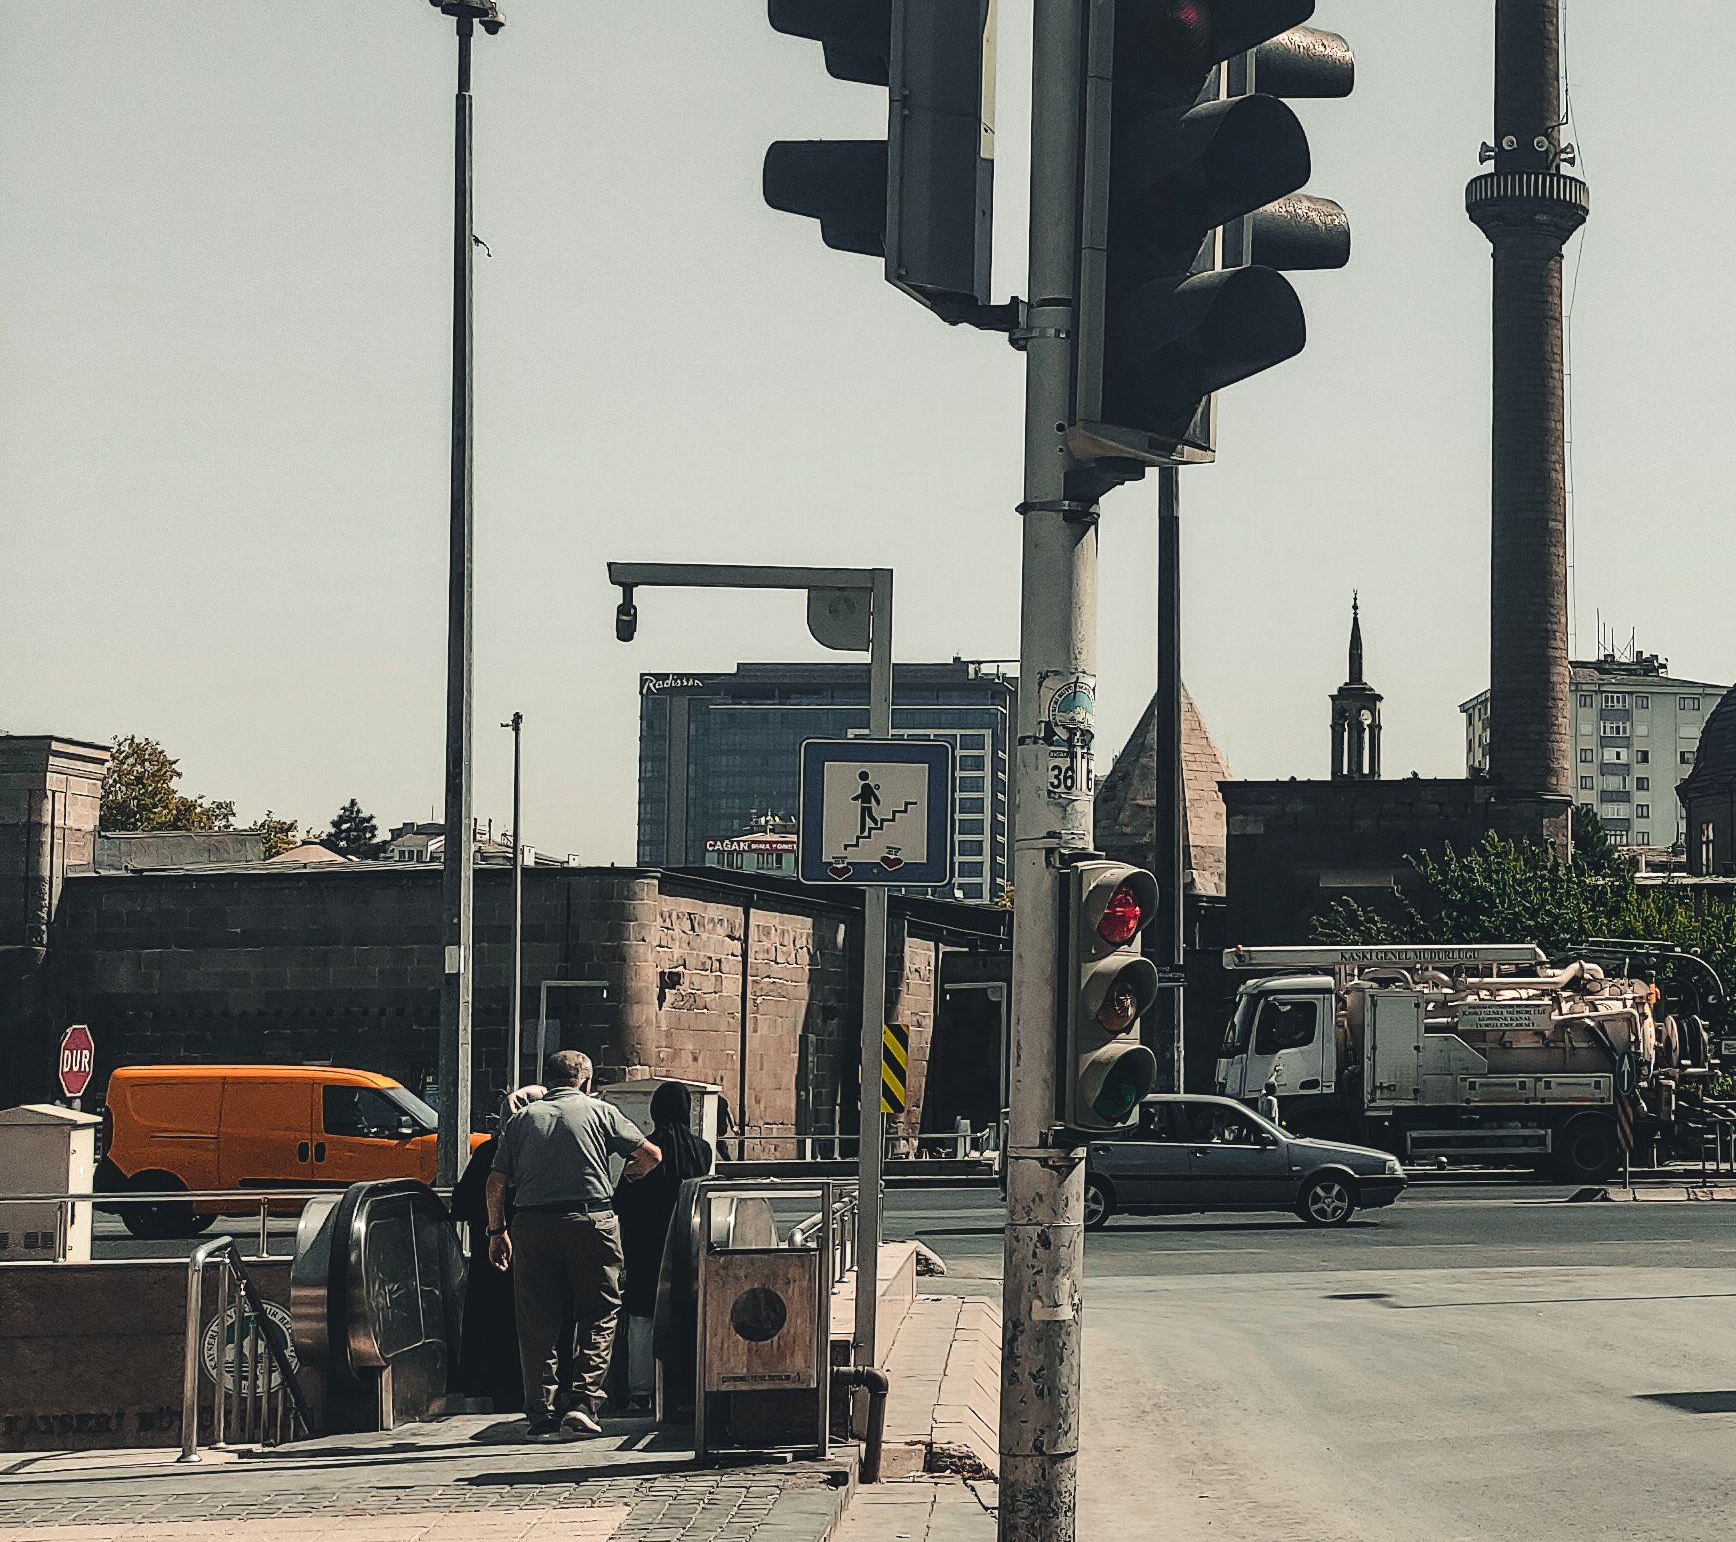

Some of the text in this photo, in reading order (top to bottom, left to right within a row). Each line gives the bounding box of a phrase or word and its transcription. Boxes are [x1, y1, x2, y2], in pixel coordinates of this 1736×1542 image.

[642, 673, 703, 695] Radisson
[1049, 764, 1075, 791] 36
[1375, 950, 1410, 961] GENEL
[63, 1049, 90, 1072] DUR
